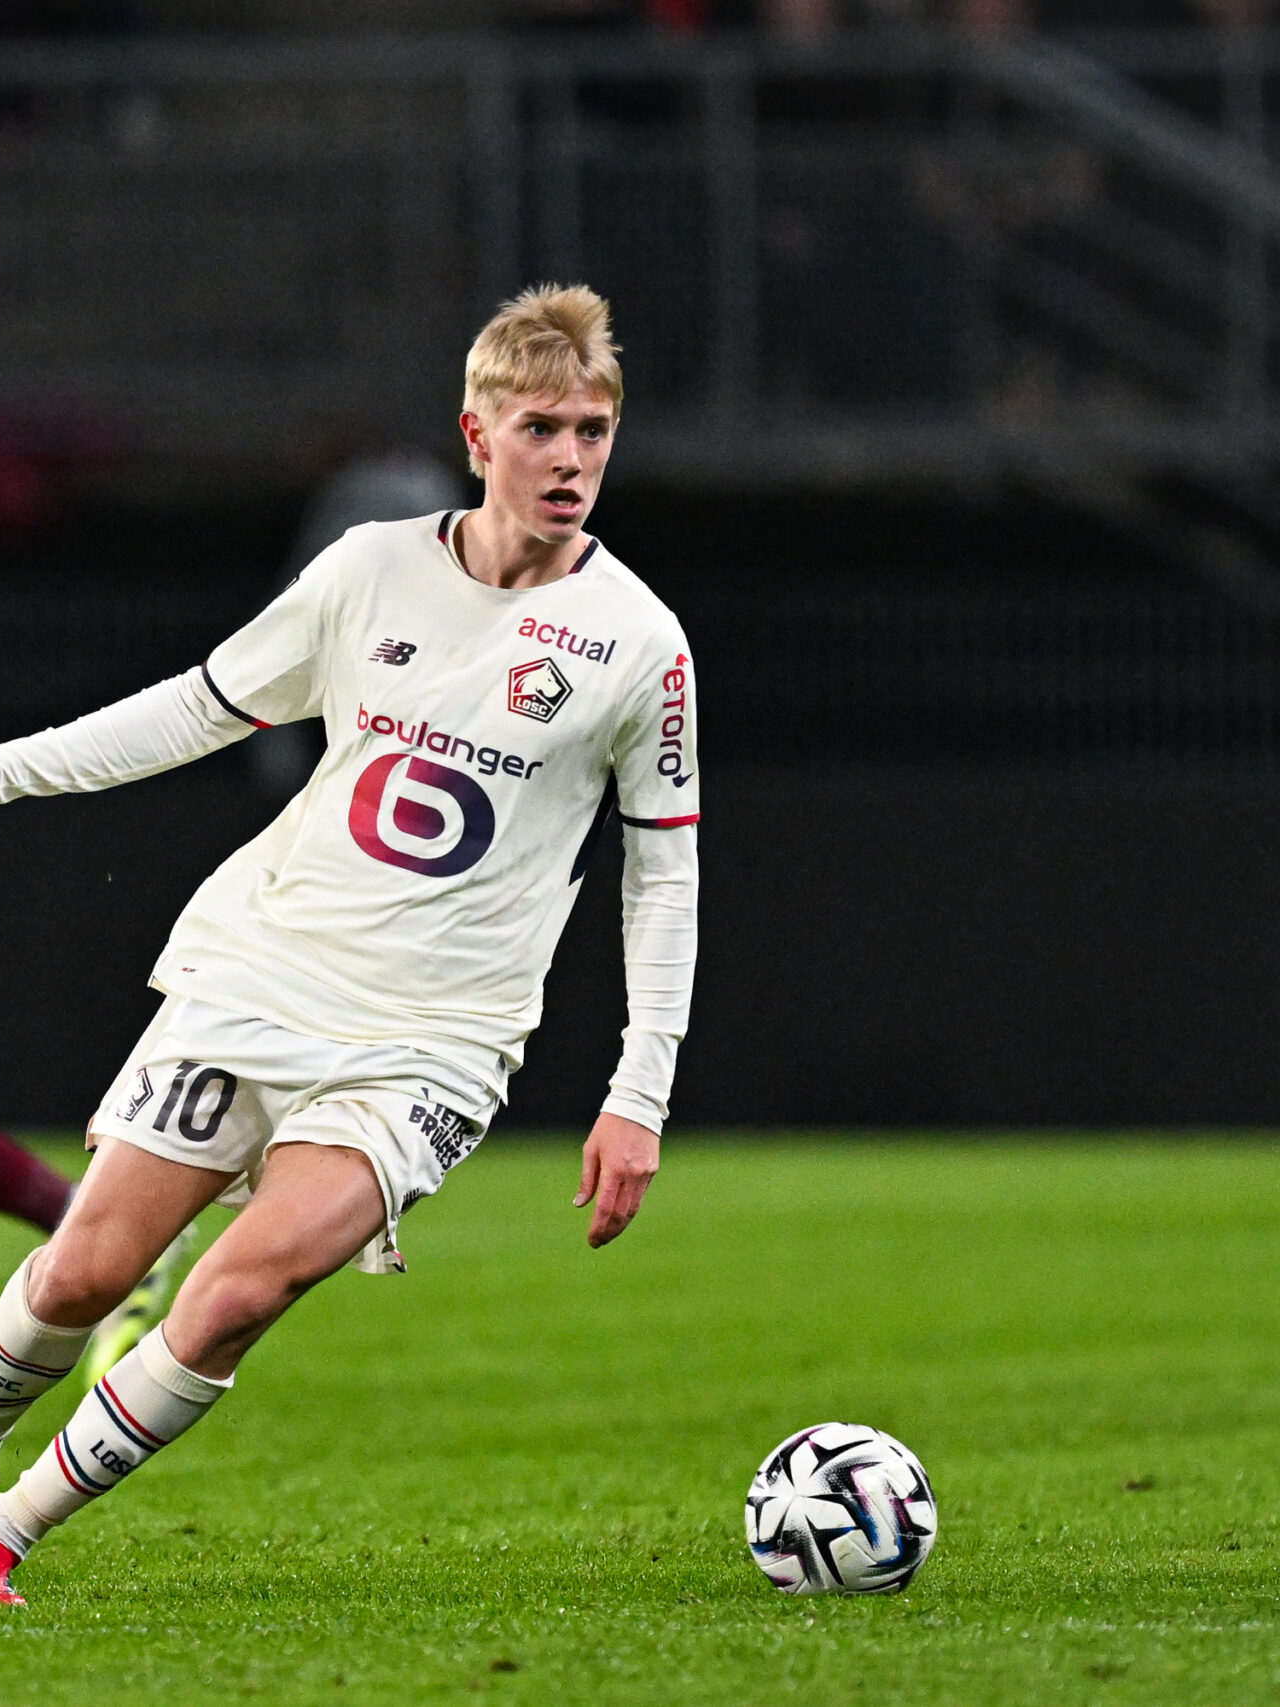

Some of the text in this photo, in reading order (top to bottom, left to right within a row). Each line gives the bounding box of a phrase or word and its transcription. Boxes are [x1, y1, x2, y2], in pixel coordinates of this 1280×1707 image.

[519, 617, 616, 665] actual
[515, 696, 548, 716] LOSC
[357, 702, 544, 780] boulanger
[152, 1060, 238, 1142] 10
